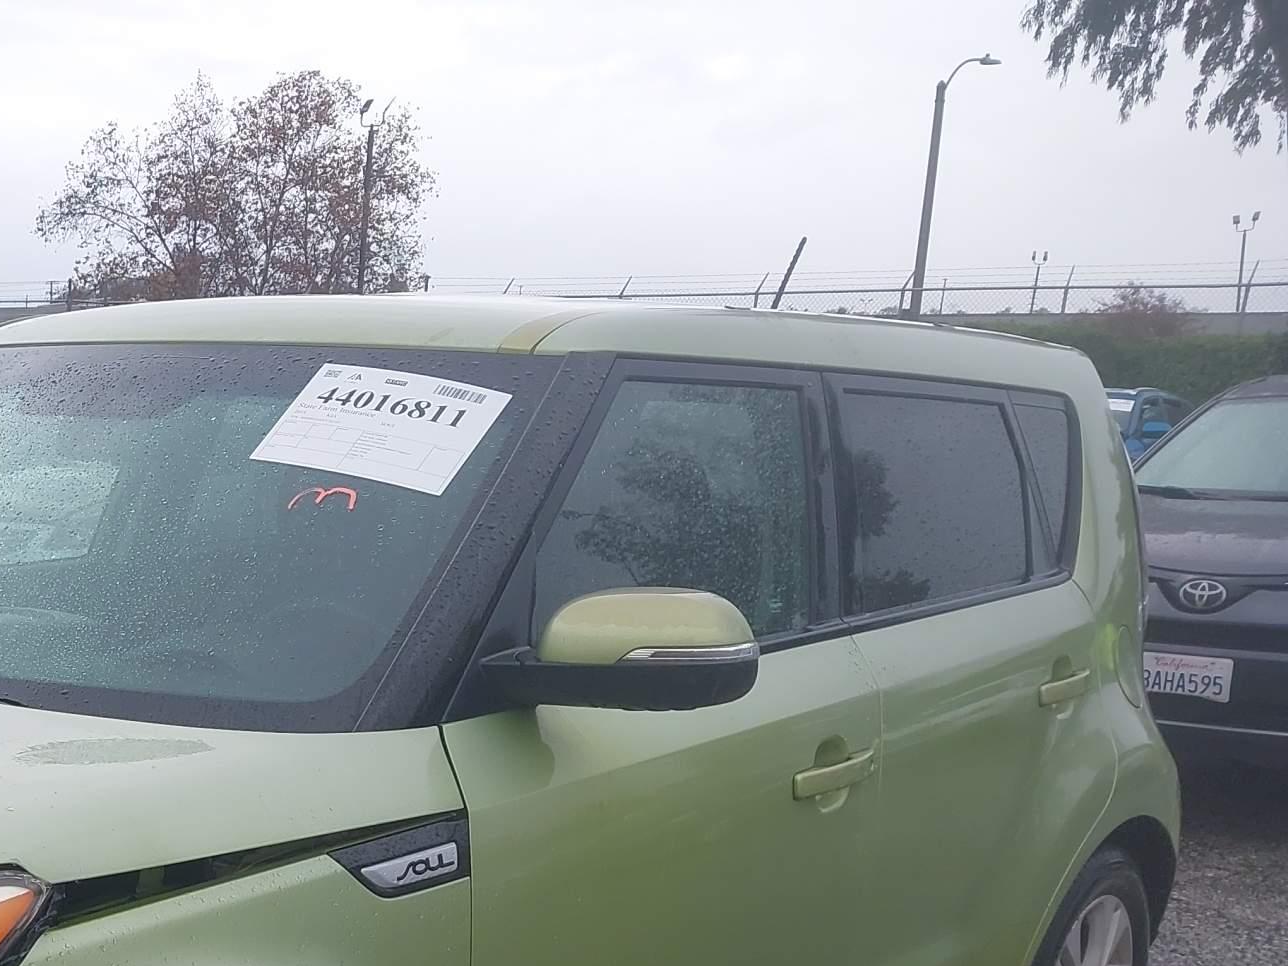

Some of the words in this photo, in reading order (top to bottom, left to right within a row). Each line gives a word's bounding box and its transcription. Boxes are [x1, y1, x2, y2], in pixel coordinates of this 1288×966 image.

[298, 402, 318, 410] State
[318, 404, 338, 412] Farm
[339, 406, 377, 418] Insurance
[317, 387, 467, 428] 44016811
